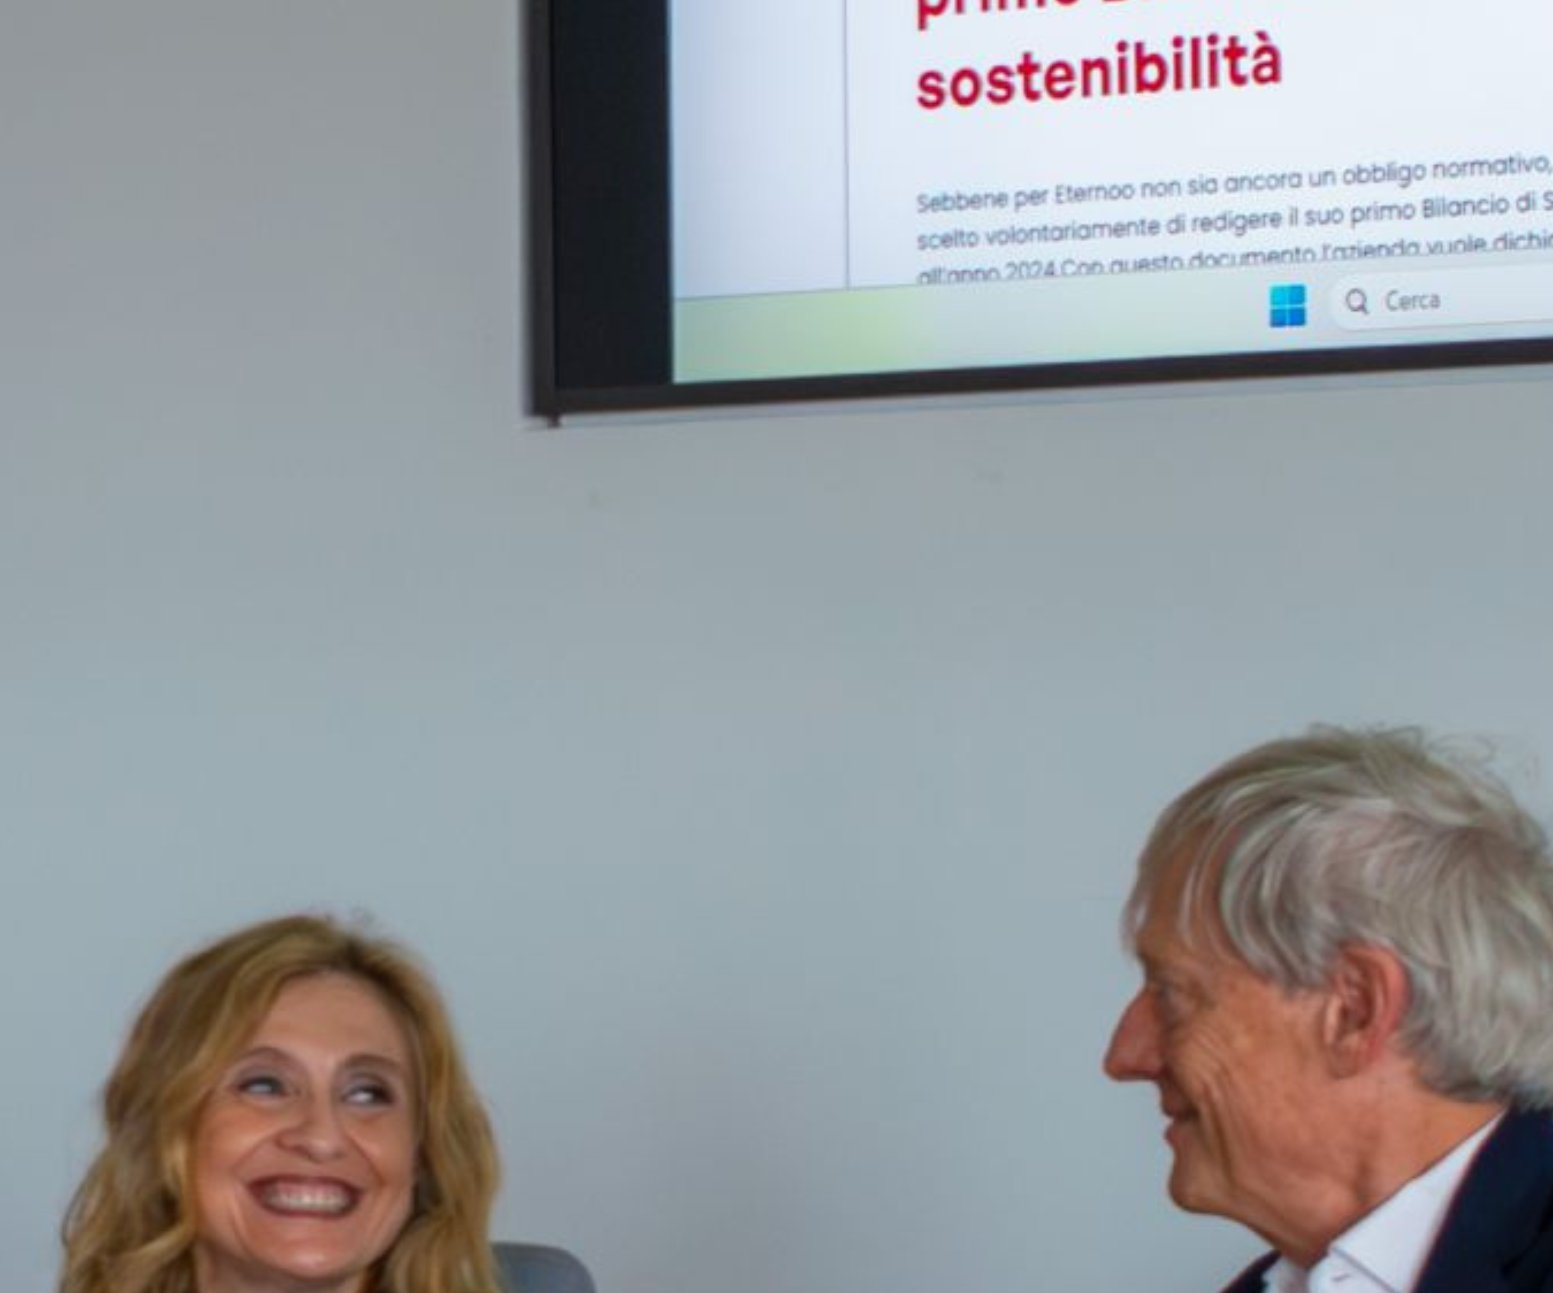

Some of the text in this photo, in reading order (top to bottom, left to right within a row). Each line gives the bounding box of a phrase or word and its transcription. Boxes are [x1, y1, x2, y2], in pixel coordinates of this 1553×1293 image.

[917, 29, 1282, 109] sostenibilità
[916, 190, 1008, 213] Sebbene
[1014, 188, 1048, 212] per
[1055, 183, 1133, 205] Eternoo
[1141, 179, 1181, 198] non
[1187, 174, 1218, 195] sia
[1225, 172, 1302, 193] ancora
[1308, 168, 1336, 187] un
[1343, 162, 1427, 188] obbligo
[916, 229, 980, 250] scelto
[986, 219, 1161, 246] volontariamente
[1167, 214, 1186, 235] di
[1191, 207, 1282, 236] redigere
[1288, 202, 1299, 225] il
[1305, 206, 1344, 227] suo
[1350, 200, 1416, 228] primo
[1422, 194, 1509, 220] Bilancio
[1516, 190, 1536, 213] di
[1385, 289, 1440, 312] Cerca
